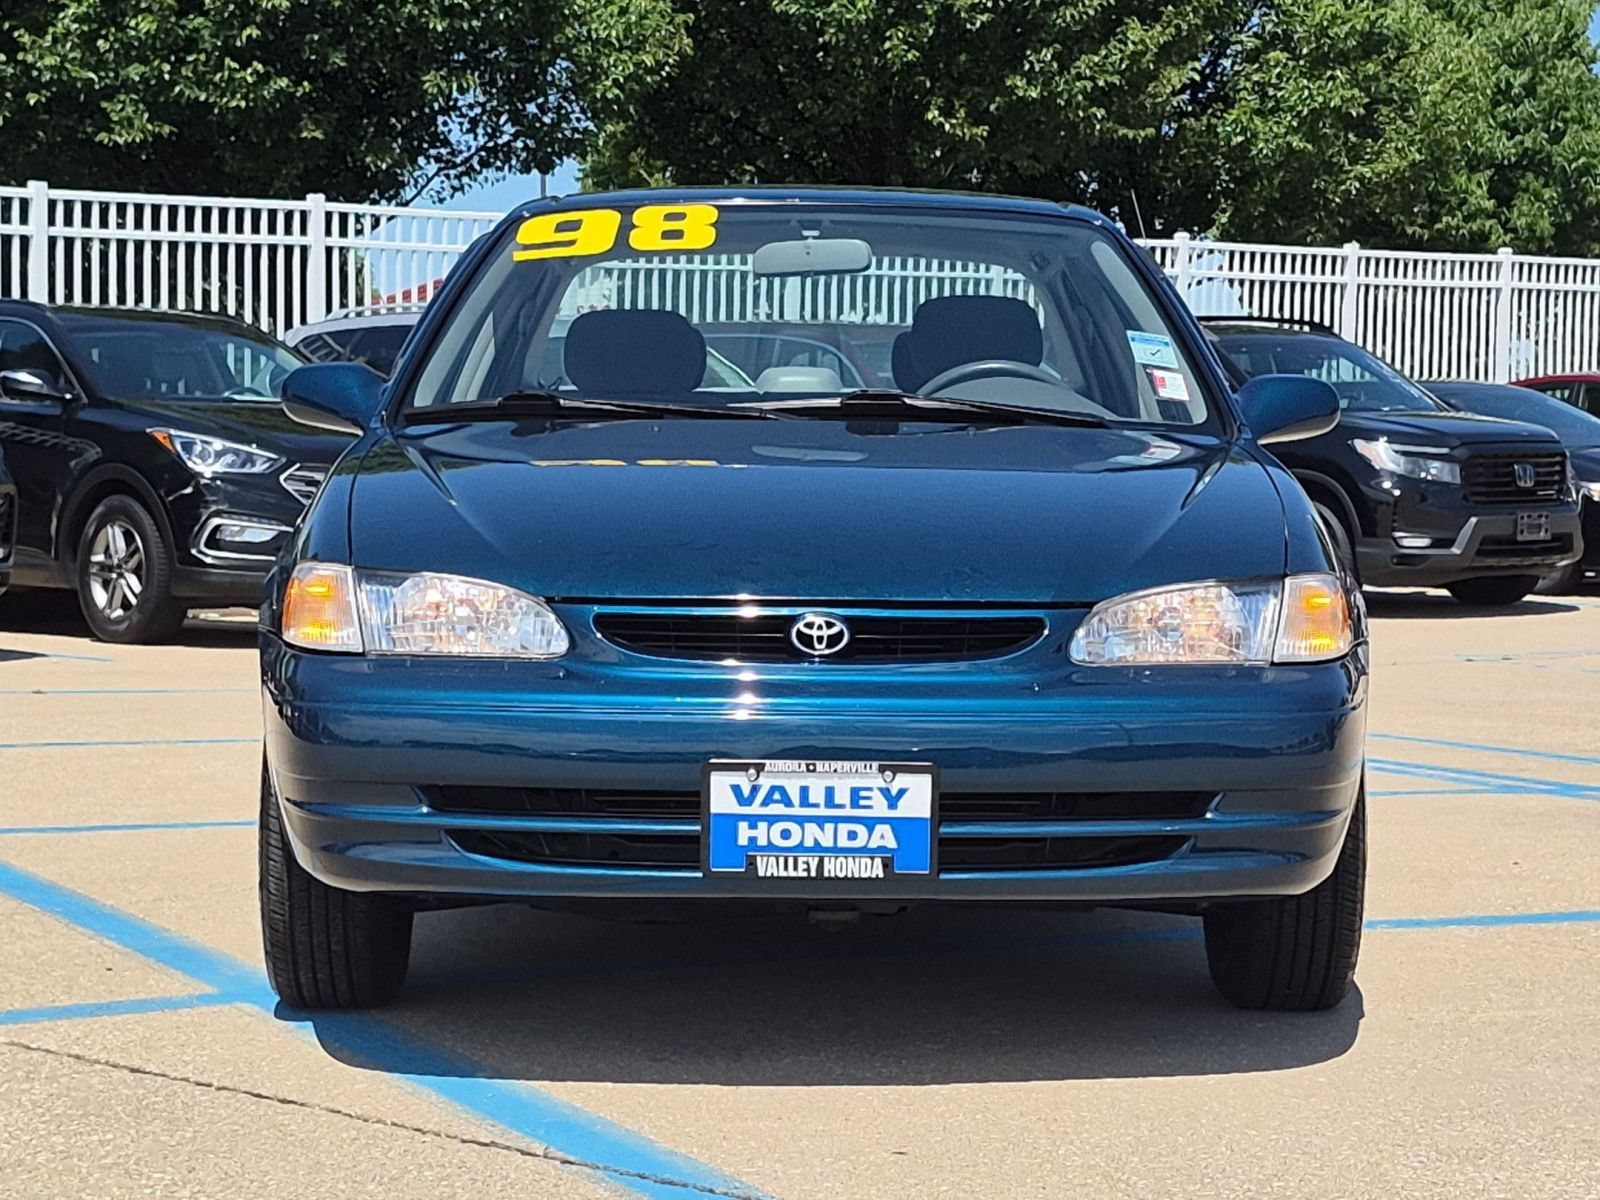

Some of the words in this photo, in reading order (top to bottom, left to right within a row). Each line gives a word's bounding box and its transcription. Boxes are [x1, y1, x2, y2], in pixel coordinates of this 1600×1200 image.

[512, 204, 719, 262] 98
[729, 784, 910, 810] VALLEY
[736, 821, 898, 849] HONDA
[757, 855, 818, 877] VALLEY
[823, 856, 884, 879] HONDA
